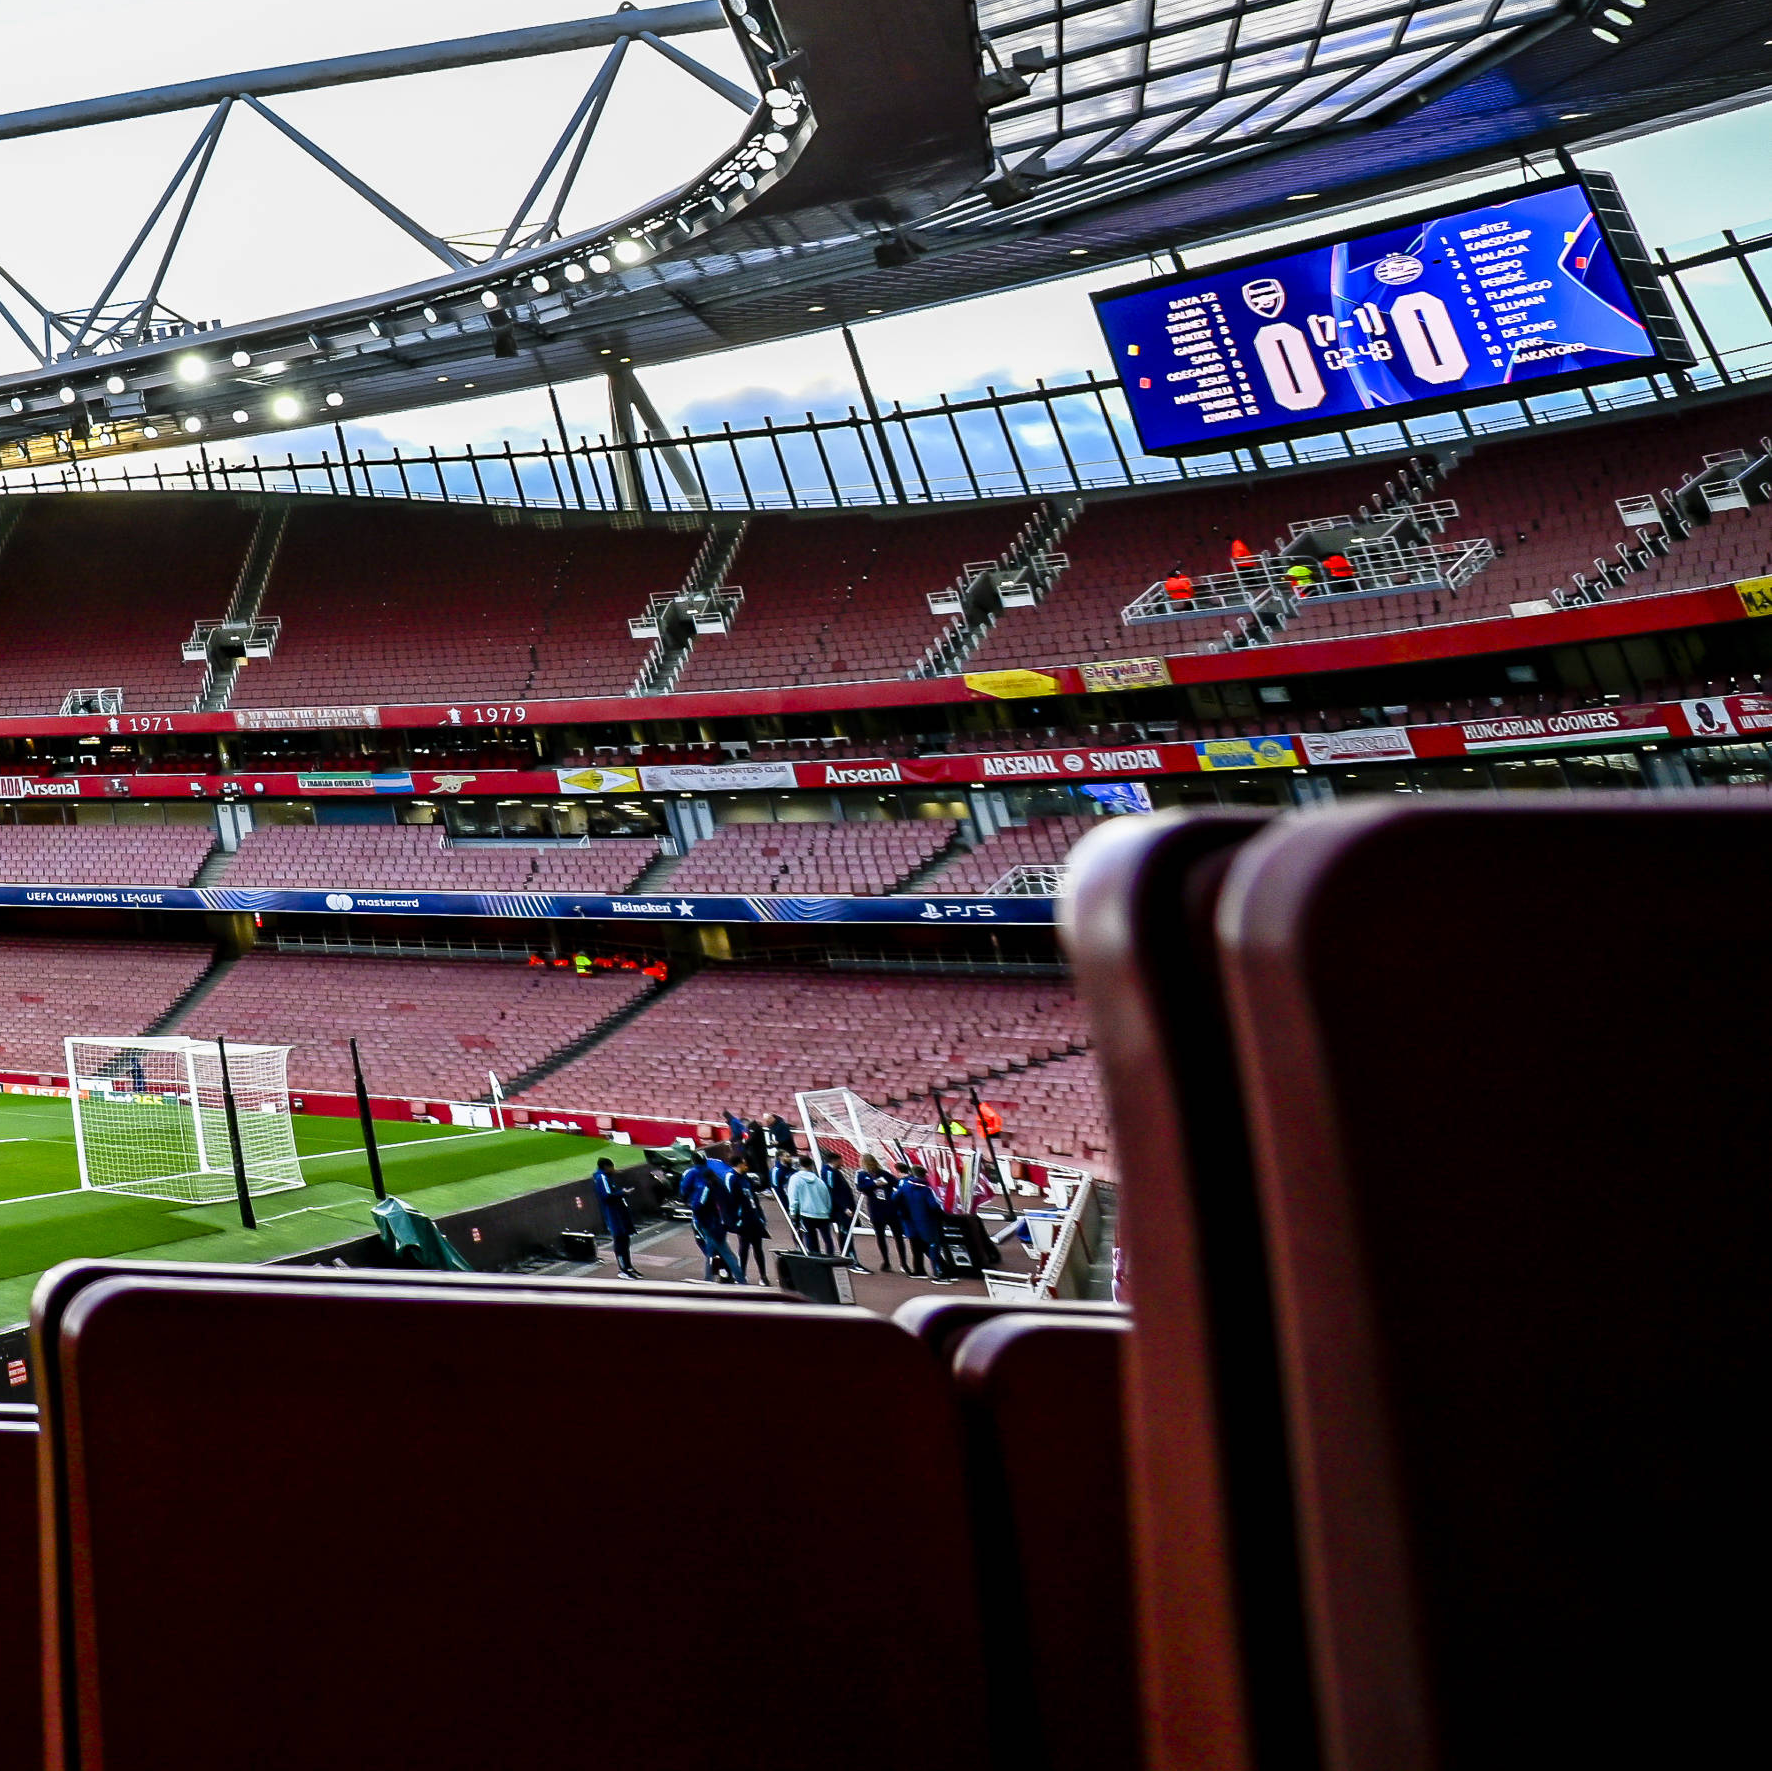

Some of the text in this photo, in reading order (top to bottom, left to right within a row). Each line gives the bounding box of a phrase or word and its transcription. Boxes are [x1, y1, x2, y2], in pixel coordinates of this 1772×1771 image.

[1440, 237, 1449, 245] 1
[1445, 230, 1532, 257] 2 KARSDORP
[1450, 244, 1530, 269] 3 MALACIA
[1457, 272, 1467, 280] 4
[1461, 284, 1472, 294] 5
[1466, 280, 1553, 306] 6 FLAMINGO
[1169, 292, 1218, 309] RAYA 22
[1470, 294, 1546, 318] 7 TILLMAN
[1211, 304, 1222, 313] 2
[1215, 315, 1226, 323] 3
[1476, 311, 1528, 331] 8 DEST
[1219, 326, 1230, 334] 5
[1481, 320, 1557, 343] 9 DE JONG
[1224, 337, 1234, 345] 6
[1390, 291, 1470, 384] 0
[1486, 336, 1545, 355] 10 LANG
[1190, 349, 1237, 364] SAKA 7
[1324, 340, 1393, 371] 02:48
[1232, 360, 1243, 368] 8
[1254, 323, 1326, 411] 0
[1491, 358, 1504, 368] 11
[1197, 371, 1247, 388] JESUS 9
[1241, 394, 1256, 404] 12
[1245, 406, 1260, 415] 15
[1085, 666, 1114, 677] SHE
[248, 708, 360, 720] WE WON THE LEAGUE
[473, 707, 526, 723] 1979
[129, 717, 174, 731] 1971
[1462, 711, 1620, 740] HUNGARIAN GOONERS
[1330, 728, 1408, 754] Arsenal
[983, 749, 1162, 776] ARSENAL SWEDEN
[670, 765, 788, 776] ARSENAL SUPPORTERS CLUB
[825, 762, 903, 784] Arsenal
[23, 780, 80, 796] Arsenal
[26, 891, 163, 905] UEFA CHAMPIONS LEAGUE
[357, 897, 420, 909] mastercard
[612, 900, 670, 914] Heineken
[946, 904, 996, 917] PS5
